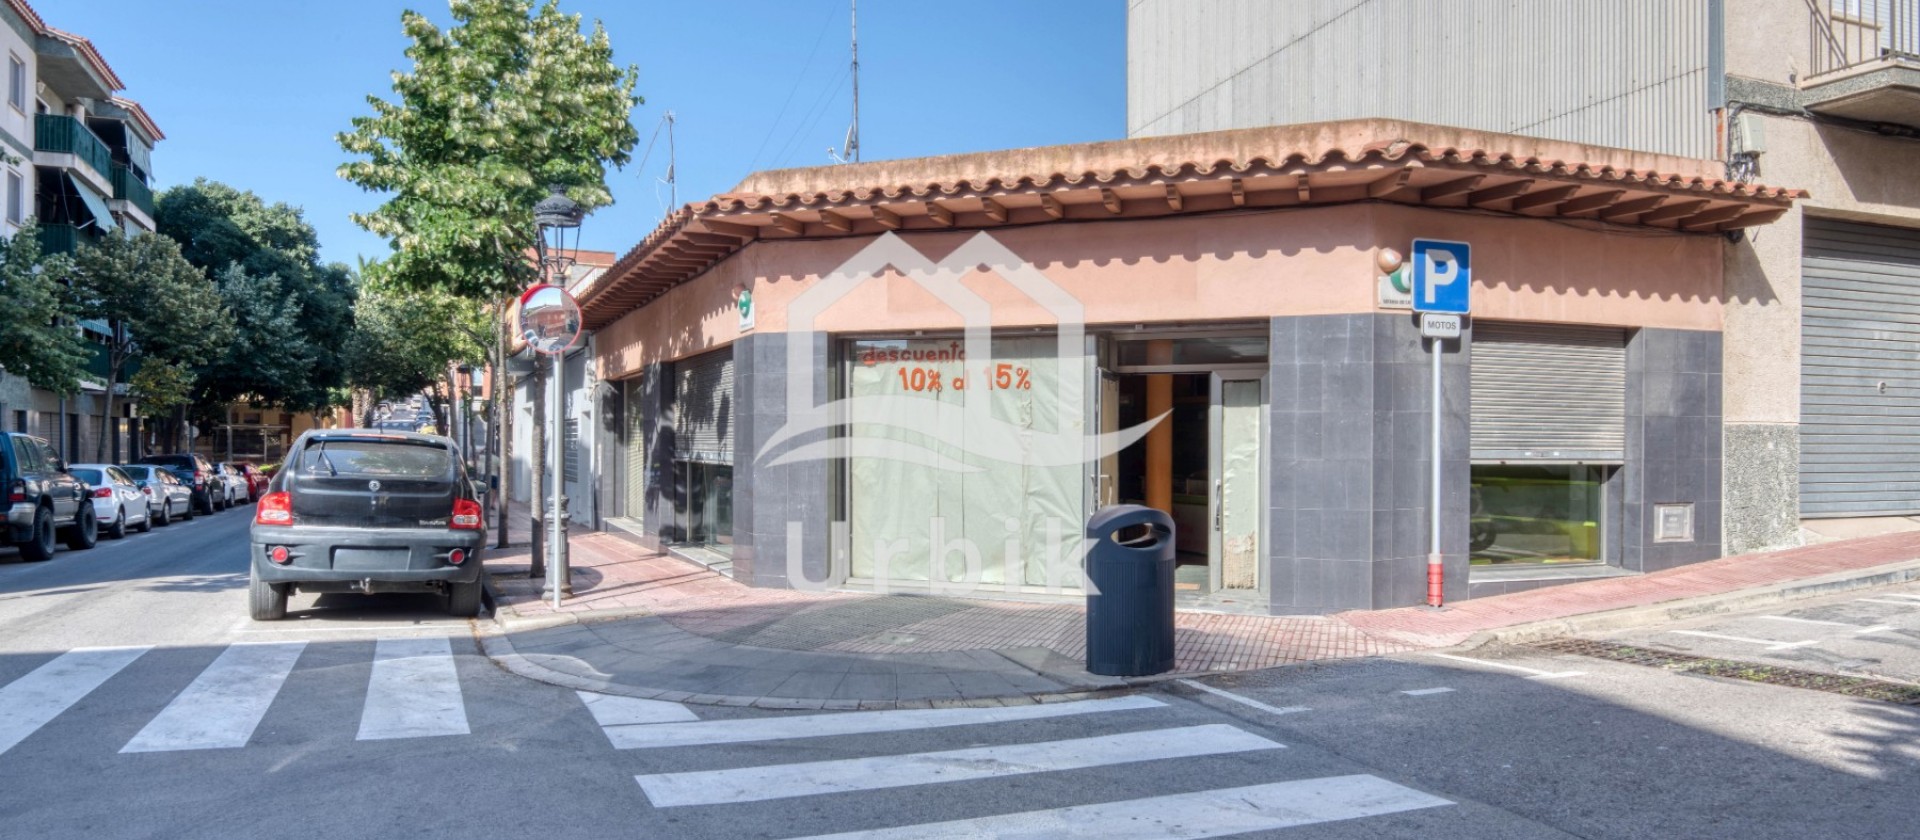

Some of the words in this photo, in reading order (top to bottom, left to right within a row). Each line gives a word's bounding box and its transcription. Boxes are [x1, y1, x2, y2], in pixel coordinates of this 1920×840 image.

[1424, 248, 1458, 303] P
[1427, 320, 1457, 331] MOTOS
[898, 366, 943, 392] 10%
[984, 363, 1032, 391] 15%
